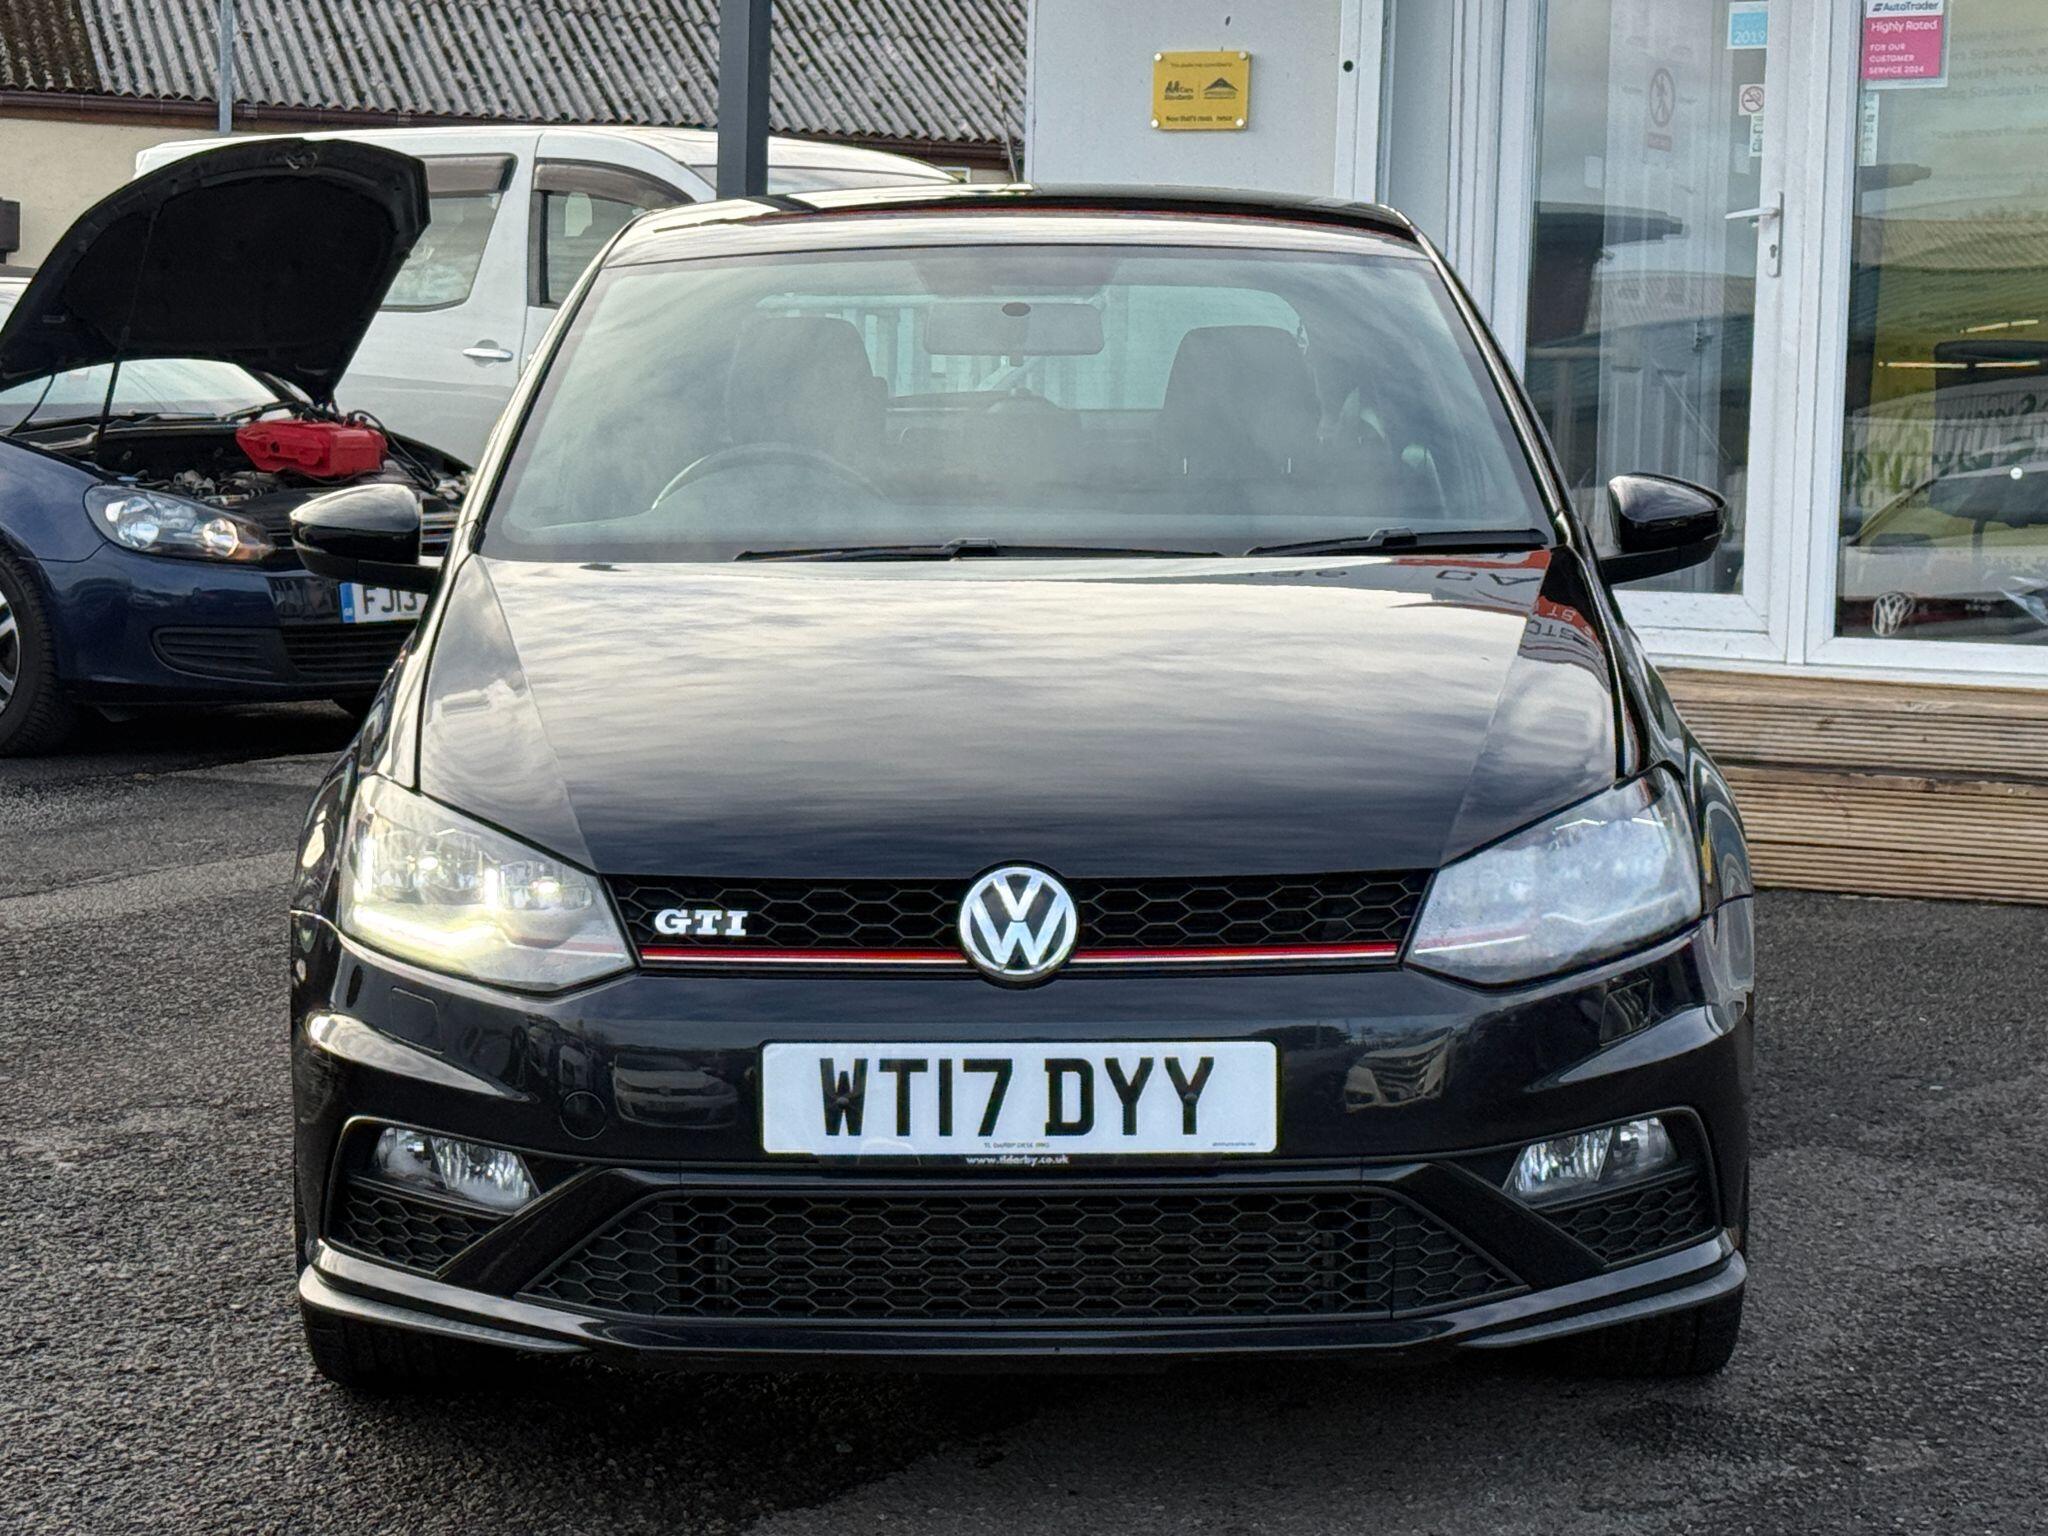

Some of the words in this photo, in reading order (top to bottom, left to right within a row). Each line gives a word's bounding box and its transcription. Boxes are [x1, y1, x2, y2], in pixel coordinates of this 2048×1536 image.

[1883, 2, 1938, 12] AutoTrader
[1870, 21, 1904, 33] Highly
[1906, 20, 1938, 31] Rated
[1734, 30, 1766, 44] 2019
[1868, 54, 1915, 62] CUSTOMER
[1868, 66, 1902, 74] SERVICE
[655, 908, 749, 936] GTI
[820, 1058, 1013, 1137] WT17
[1044, 1057, 1215, 1136] DYY
